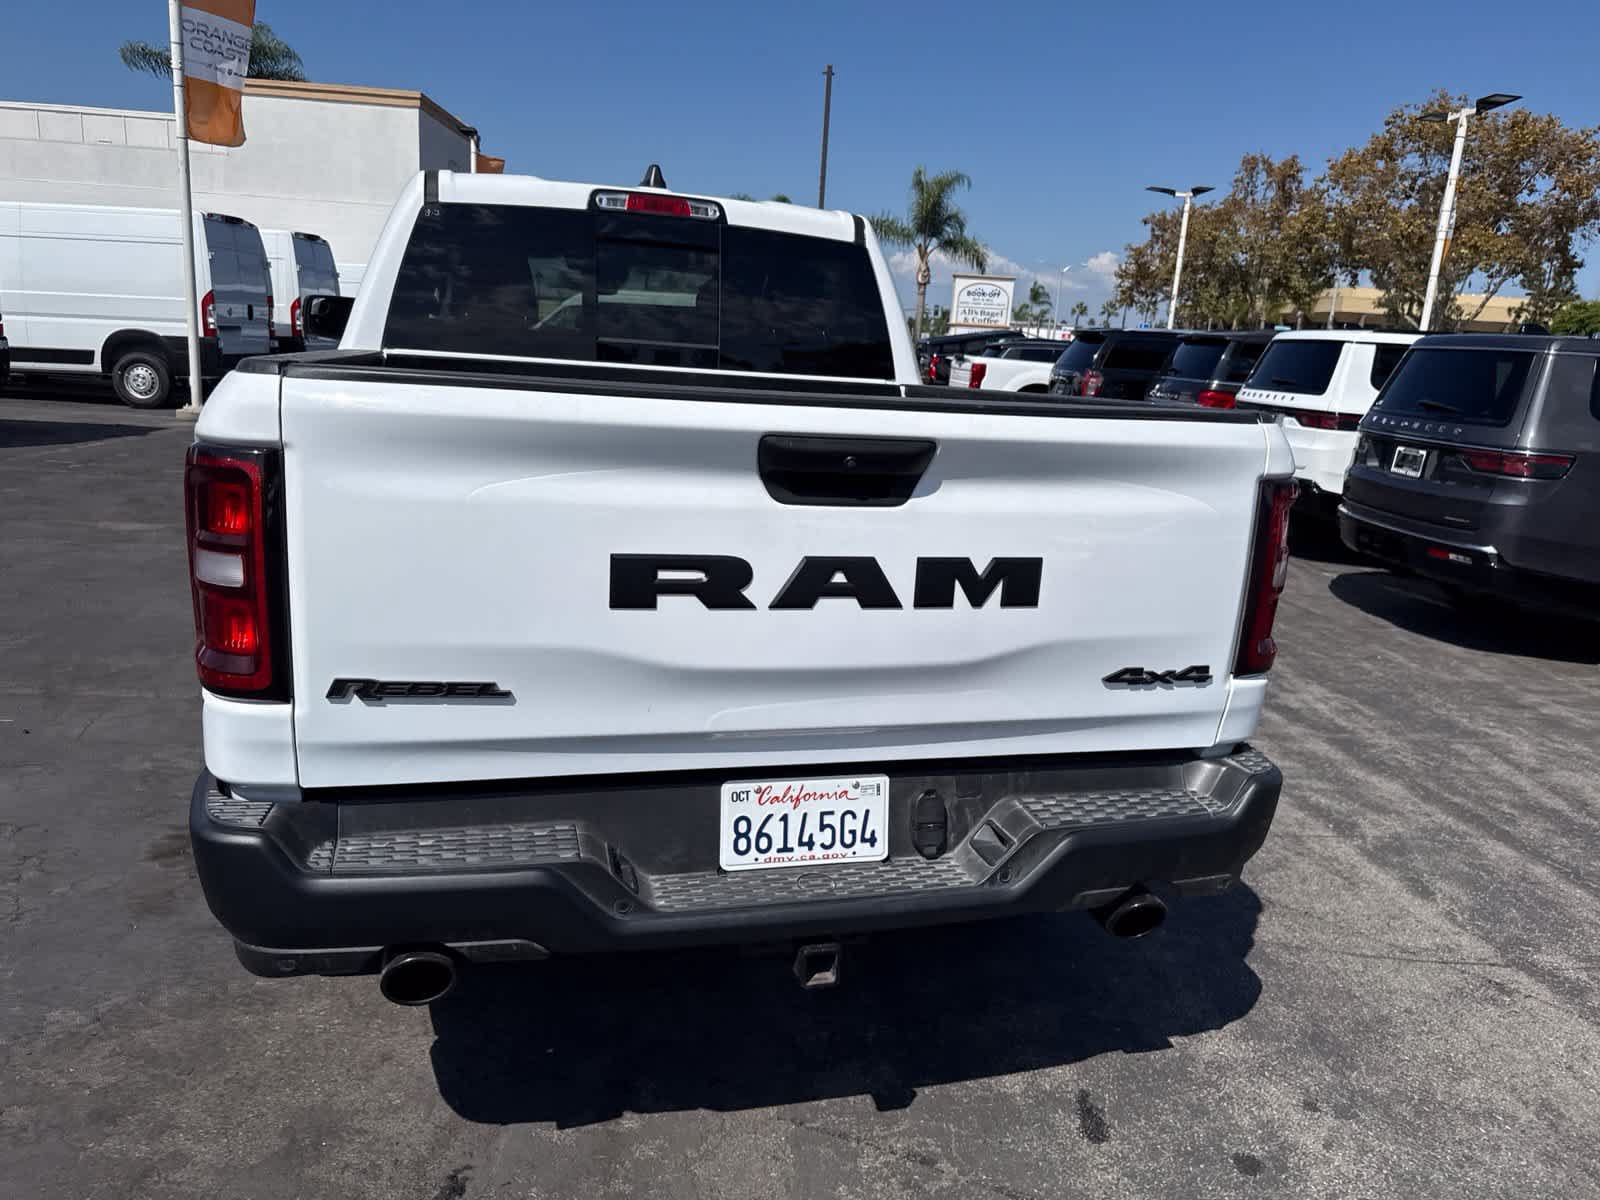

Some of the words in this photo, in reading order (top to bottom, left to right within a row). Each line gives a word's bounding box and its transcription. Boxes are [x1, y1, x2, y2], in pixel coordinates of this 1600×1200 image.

[190, 36, 247, 63] COAST
[609, 553, 1043, 611] RAM
[1101, 665, 1213, 690] 4x4
[326, 678, 516, 706] REBEL
[731, 790, 751, 803] OCT
[756, 783, 859, 810] California
[732, 808, 878, 857] 86145G4
[763, 852, 848, 864] dmv.ca.gov
